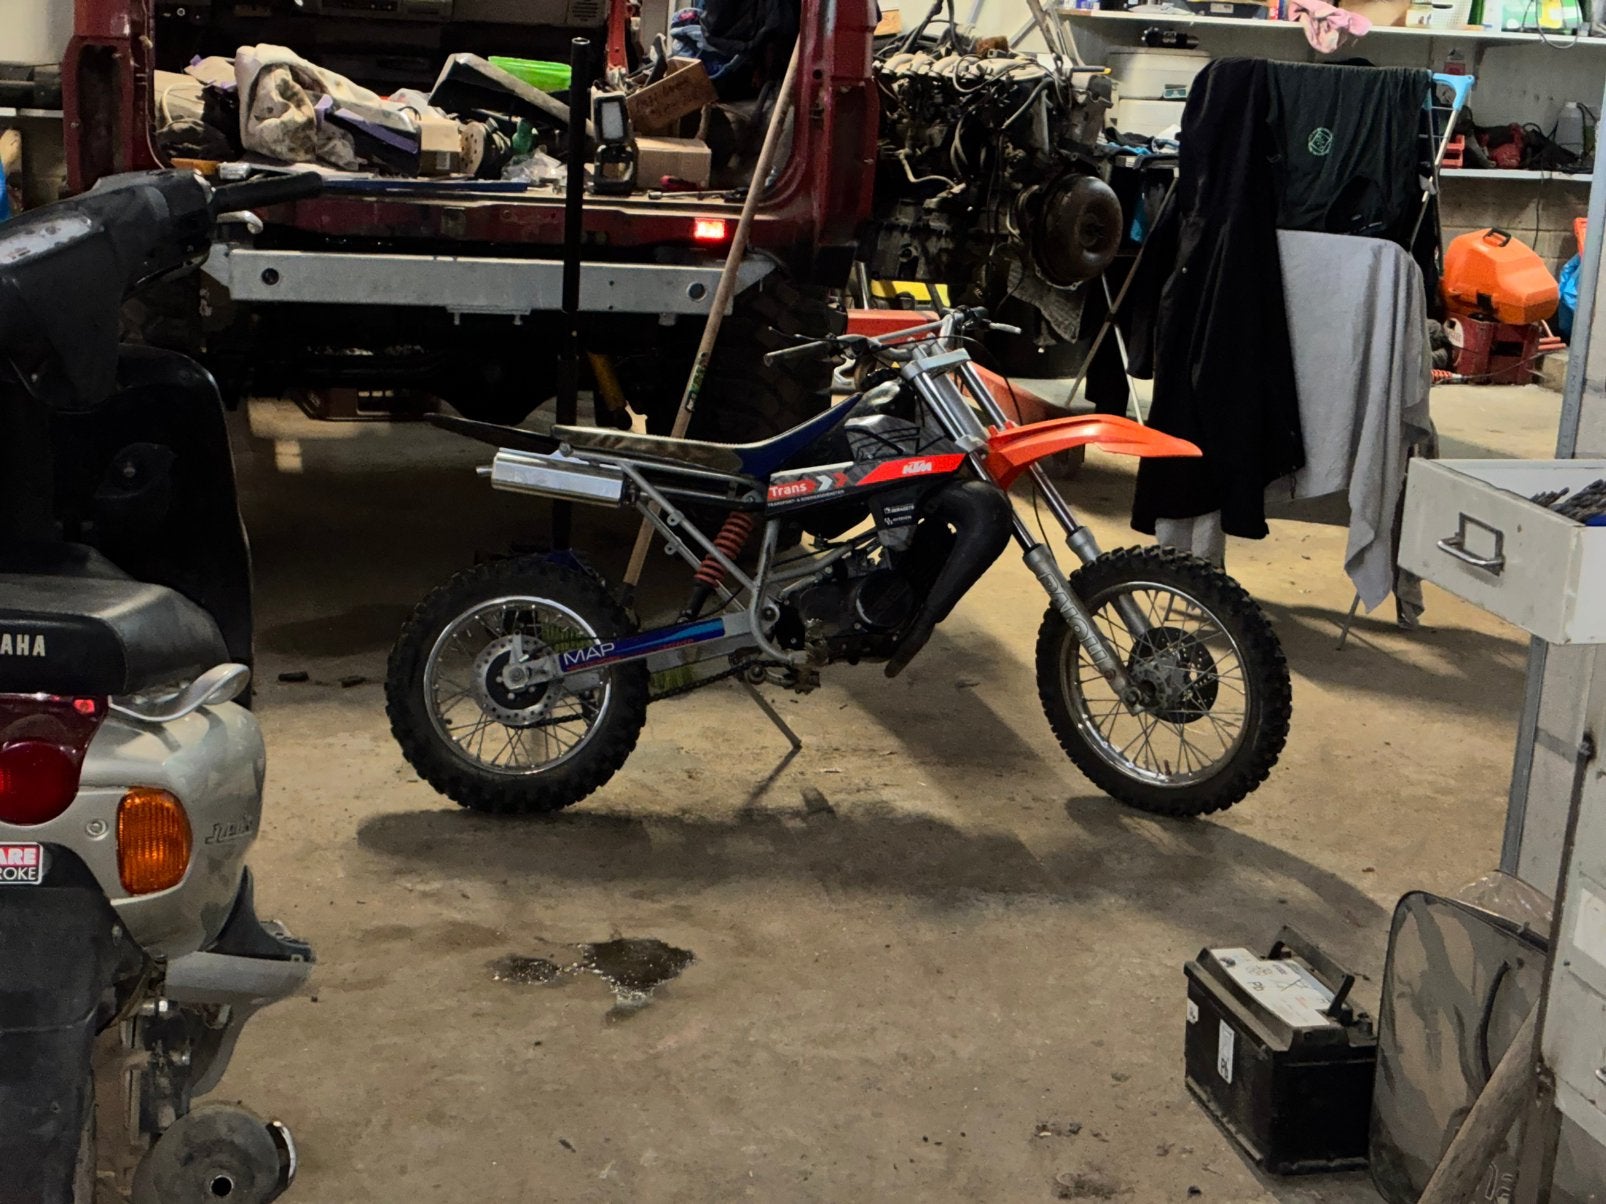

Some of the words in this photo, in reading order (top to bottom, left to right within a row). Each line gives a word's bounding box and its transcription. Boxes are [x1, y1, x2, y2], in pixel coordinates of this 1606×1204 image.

[902, 460, 932, 474] KTM
[769, 482, 807, 497] Trans
[0, 634, 46, 657] AHA
[563, 642, 615, 666] MAP
[0, 867, 37, 880] OKE
